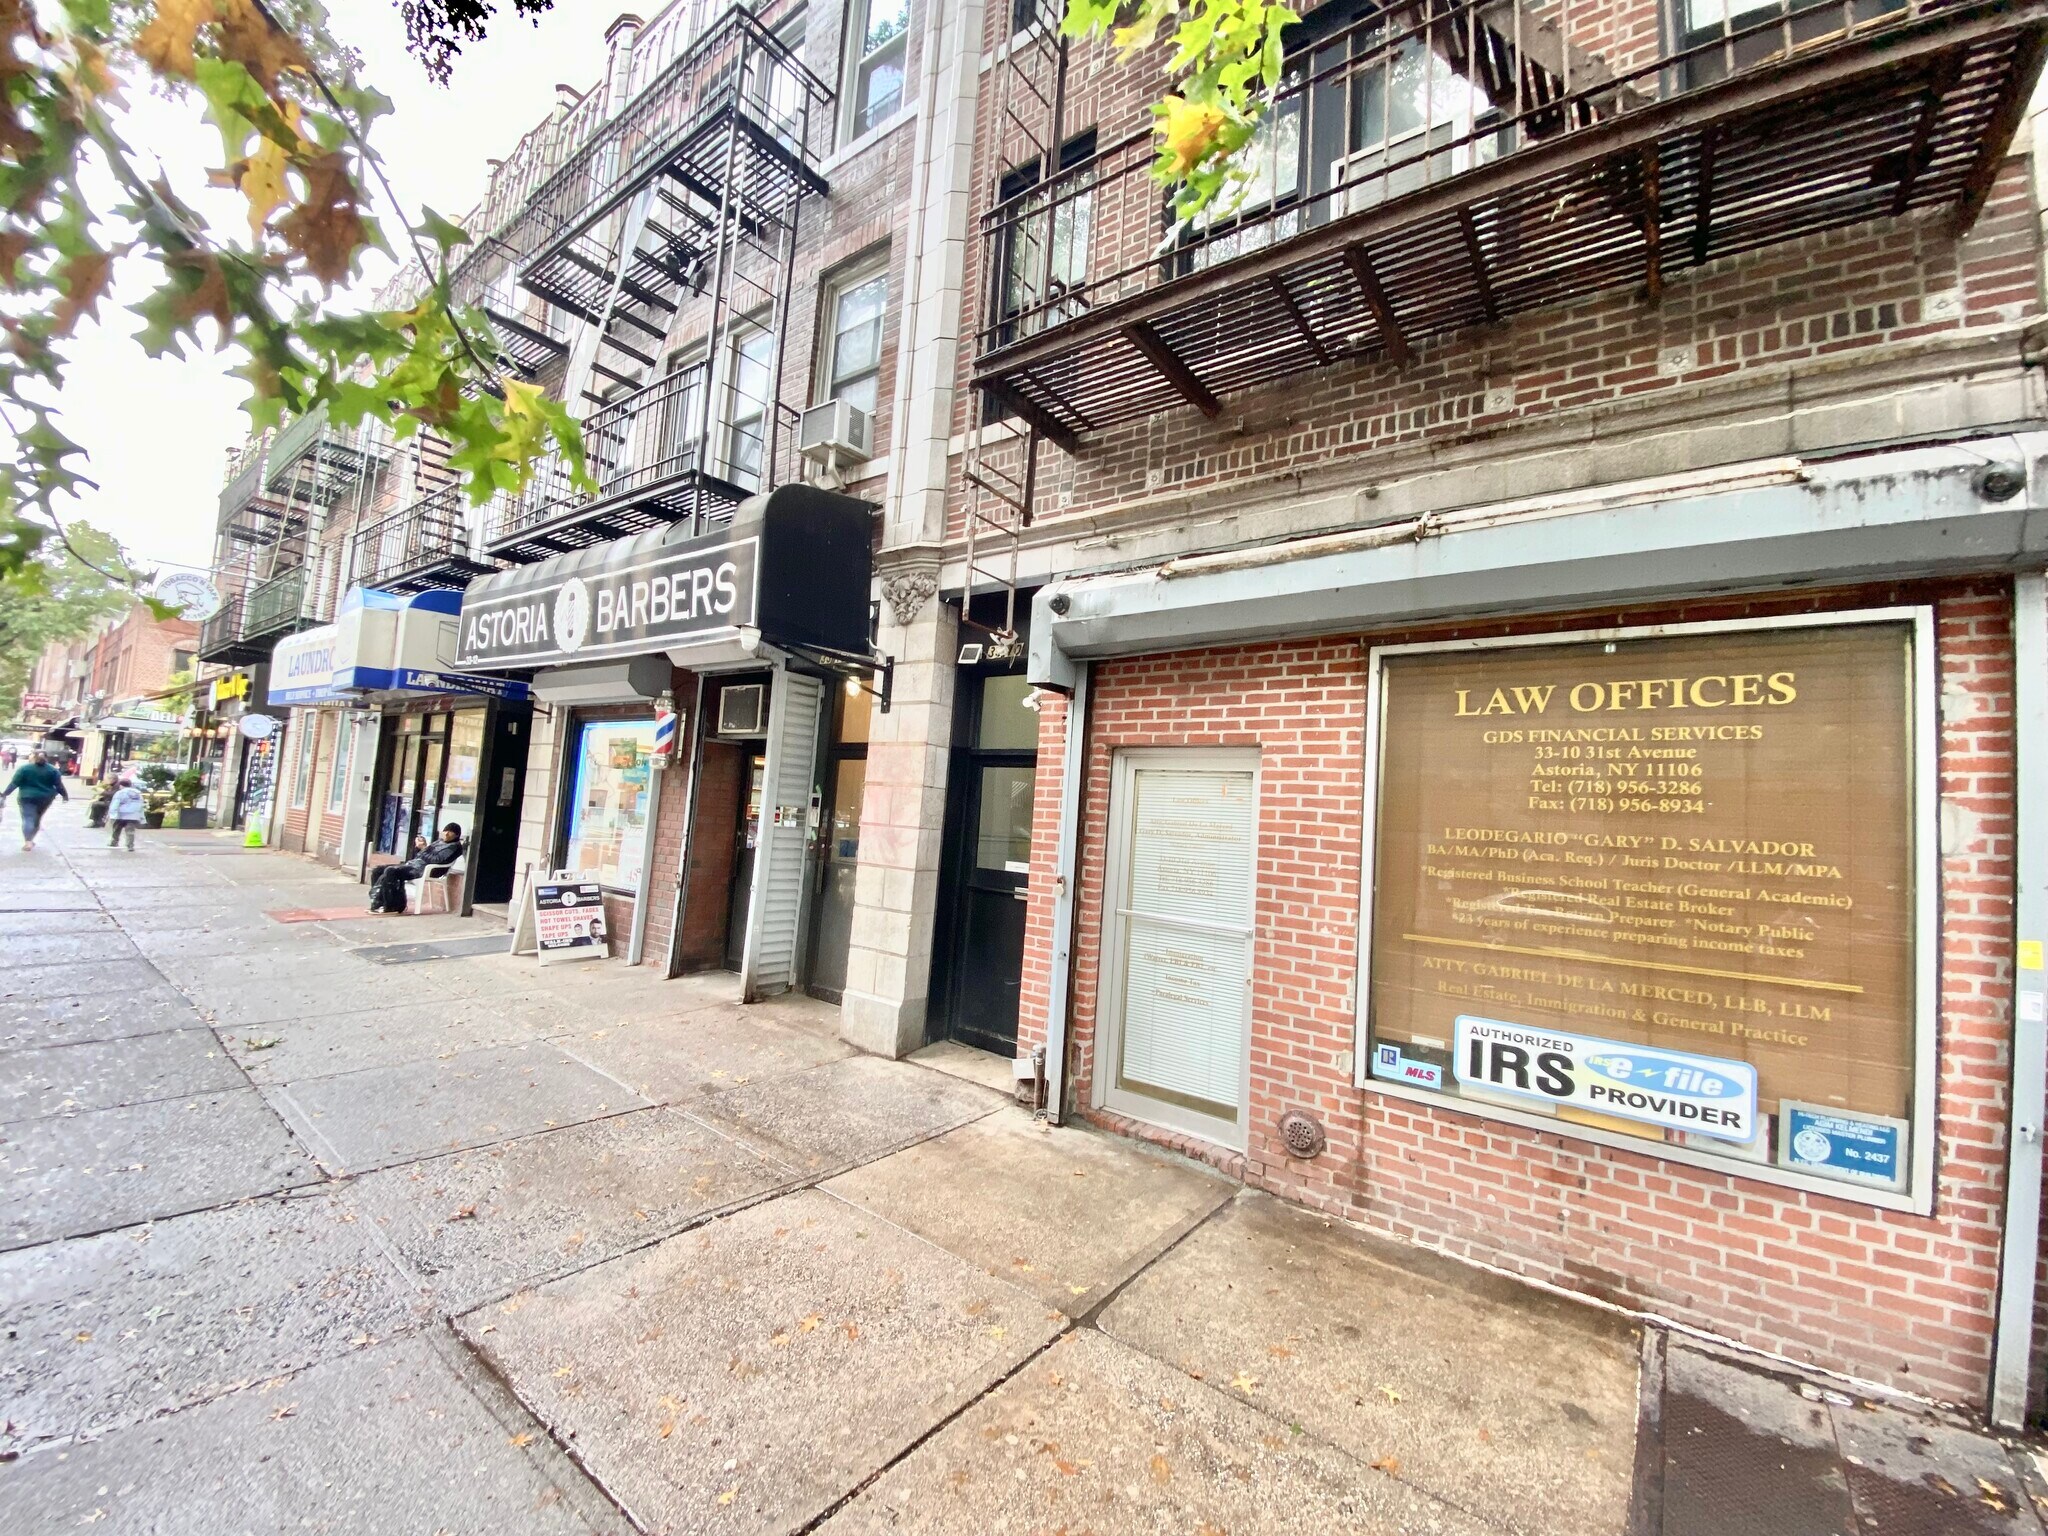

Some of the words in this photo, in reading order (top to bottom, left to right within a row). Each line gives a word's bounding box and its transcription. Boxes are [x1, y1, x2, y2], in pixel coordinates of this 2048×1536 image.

[161, 575, 198, 589] TOBACCO
[465, 603, 549, 650] ASTORIA
[597, 562, 738, 633] BARBERS
[1454, 685, 1556, 717] LAW
[1569, 672, 1798, 712] OFFICES
[1483, 731, 1523, 744] GDS
[1527, 728, 1645, 743] FINANCIAL
[1650, 725, 1763, 742] SERVICES
[1534, 746, 1581, 759] 33-10
[1585, 746, 1622, 759] 31st
[1627, 745, 1697, 759] Avenue
[1531, 763, 1601, 778] Astoria,
[1607, 763, 1639, 777] NY
[1646, 763, 1703, 777] 11106
[1530, 780, 1562, 793] Tel:
[1568, 780, 1612, 796] (718)
[1616, 781, 1702, 795] 956-3286
[1528, 797, 1564, 810] Fax:
[1570, 798, 1614, 813] (718)
[1619, 799, 1705, 813] 956-8934
[1445, 828, 1568, 845] LEODEGARIO
[1661, 837, 1682, 850] D.
[1689, 838, 1816, 857] SALVADOR
[1427, 844, 1518, 859] BA/MA/PhD
[1522, 849, 1560, 863] (Aca.
[1565, 852, 1604, 866] Req.)
[1621, 854, 1659, 868] Juris
[1664, 857, 1721, 871] Doctor
[1727, 860, 1843, 879] /LLM/MPA
[1497, 871, 1555, 886] Business
[1559, 875, 1608, 890] School
[1613, 878, 1674, 895] Teacher
[1678, 883, 1750, 900] (General
[1756, 889, 1853, 910] Academic)
[1587, 893, 1620, 907] Real
[1625, 896, 1674, 911] Estate
[1679, 900, 1736, 916] Broker
[1477, 915, 1510, 927] years
[1514, 919, 1530, 930] of
[1532, 924, 1609, 938] experience
[1612, 931, 1688, 949] preparing
[1693, 936, 1754, 953] income
[1759, 943, 1805, 958] taxes
[1609, 911, 1676, 929] Preparer
[1758, 923, 1815, 942] Public
[1473, 963, 1552, 984] GABRIEL
[1557, 974, 1584, 988] DE
[1589, 979, 1614, 993] LA
[1620, 982, 1718, 1010] MERCED,
[1779, 1002, 1832, 1021] LLM
[1438, 981, 1468, 996] Real
[1473, 986, 1522, 1005] Estate,
[1527, 993, 1627, 1019] Immigration
[1632, 1008, 1647, 1022] &
[1652, 1011, 1724, 1034] General
[1731, 1022, 1808, 1046] Practice
[1470, 1026, 1574, 1052] AUTHORIZED
[1405, 1067, 1435, 1081] MLS
[1469, 1039, 1576, 1097] IRS
[1590, 1085, 1742, 1129] PROVIDER
[1845, 1147, 1862, 1159] No.
[1864, 1151, 1890, 1164] 2437
